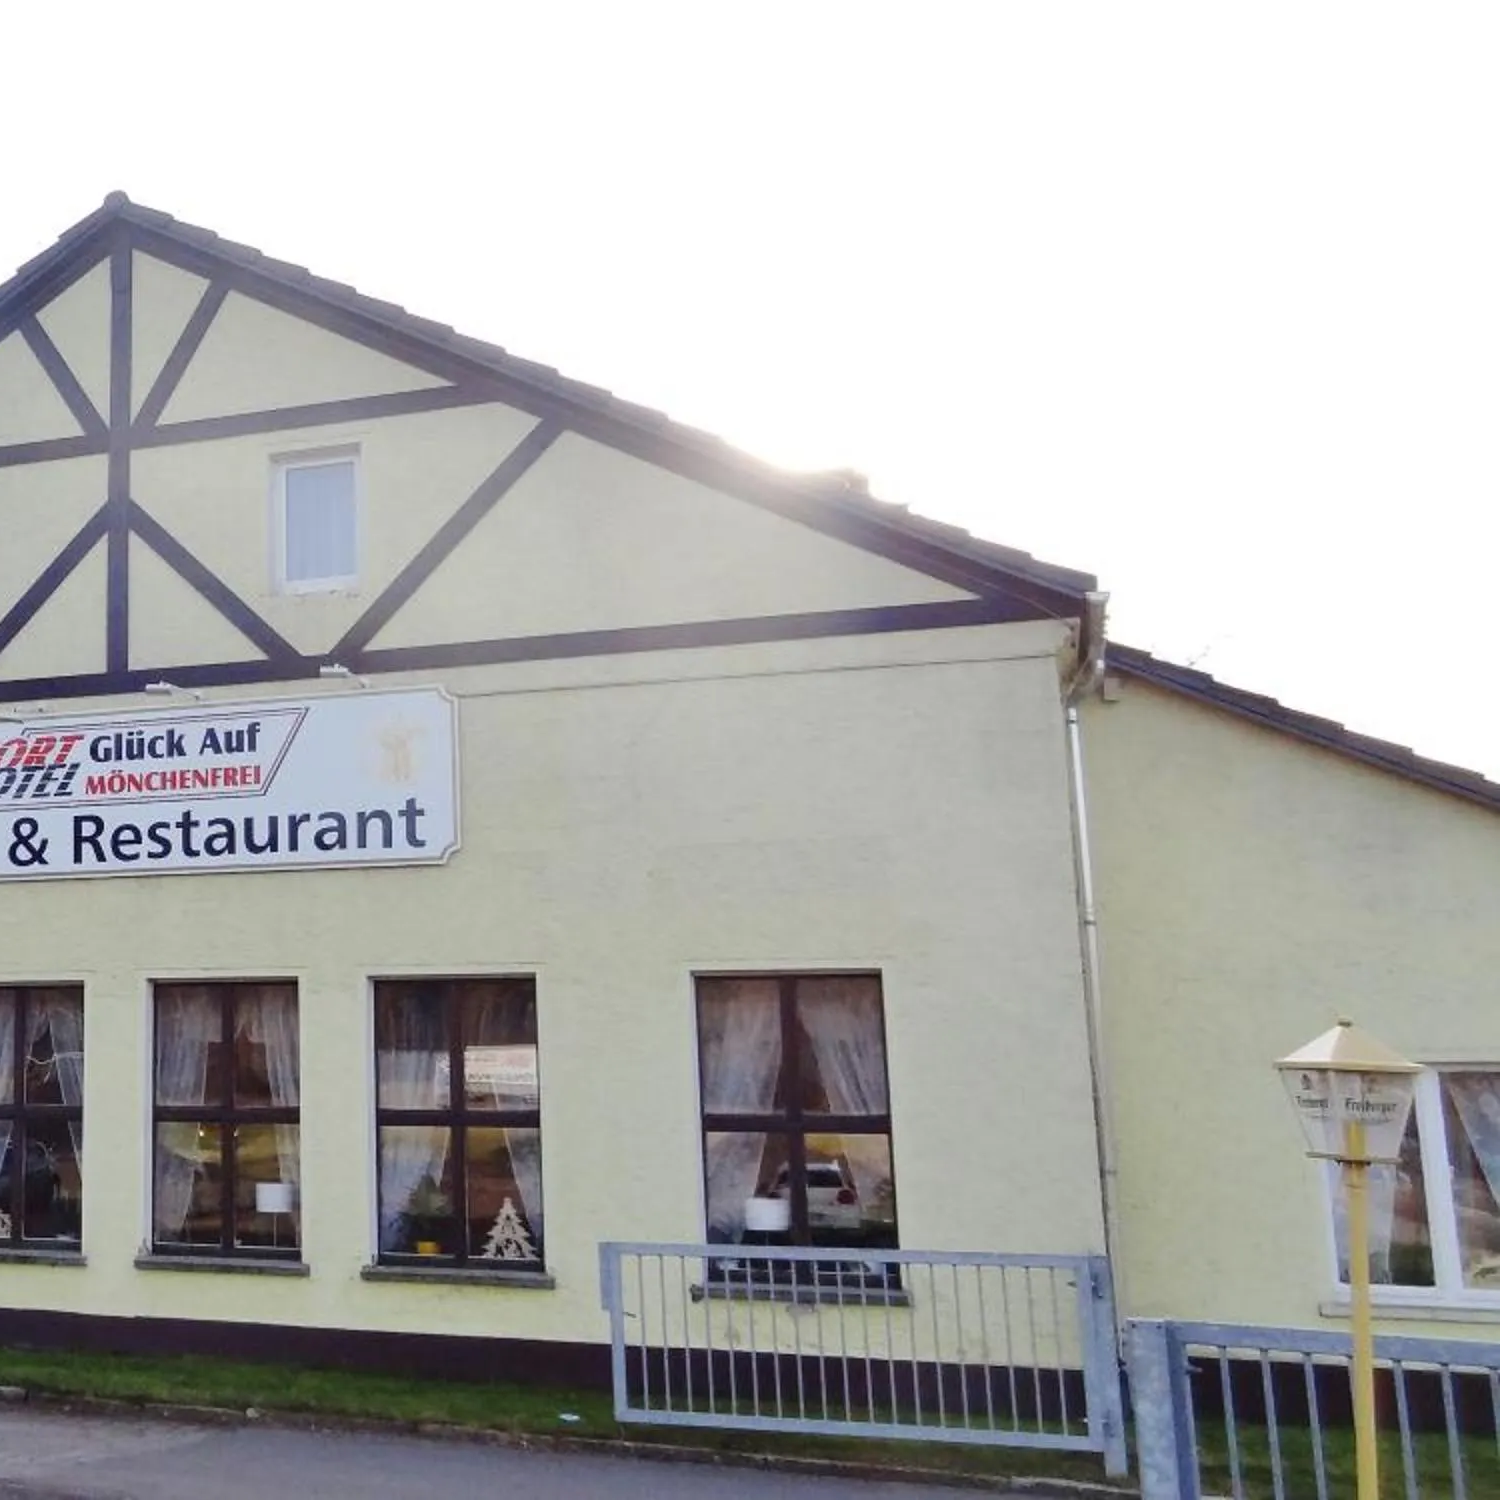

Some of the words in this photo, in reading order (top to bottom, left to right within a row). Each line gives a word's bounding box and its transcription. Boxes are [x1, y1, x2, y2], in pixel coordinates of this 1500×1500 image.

[89, 728, 187, 763] Glück
[199, 722, 261, 756] Auf
[85, 765, 261, 795] MÖNCHENFREI
[8, 816, 49, 867] &
[72, 797, 427, 865] Restaurant
